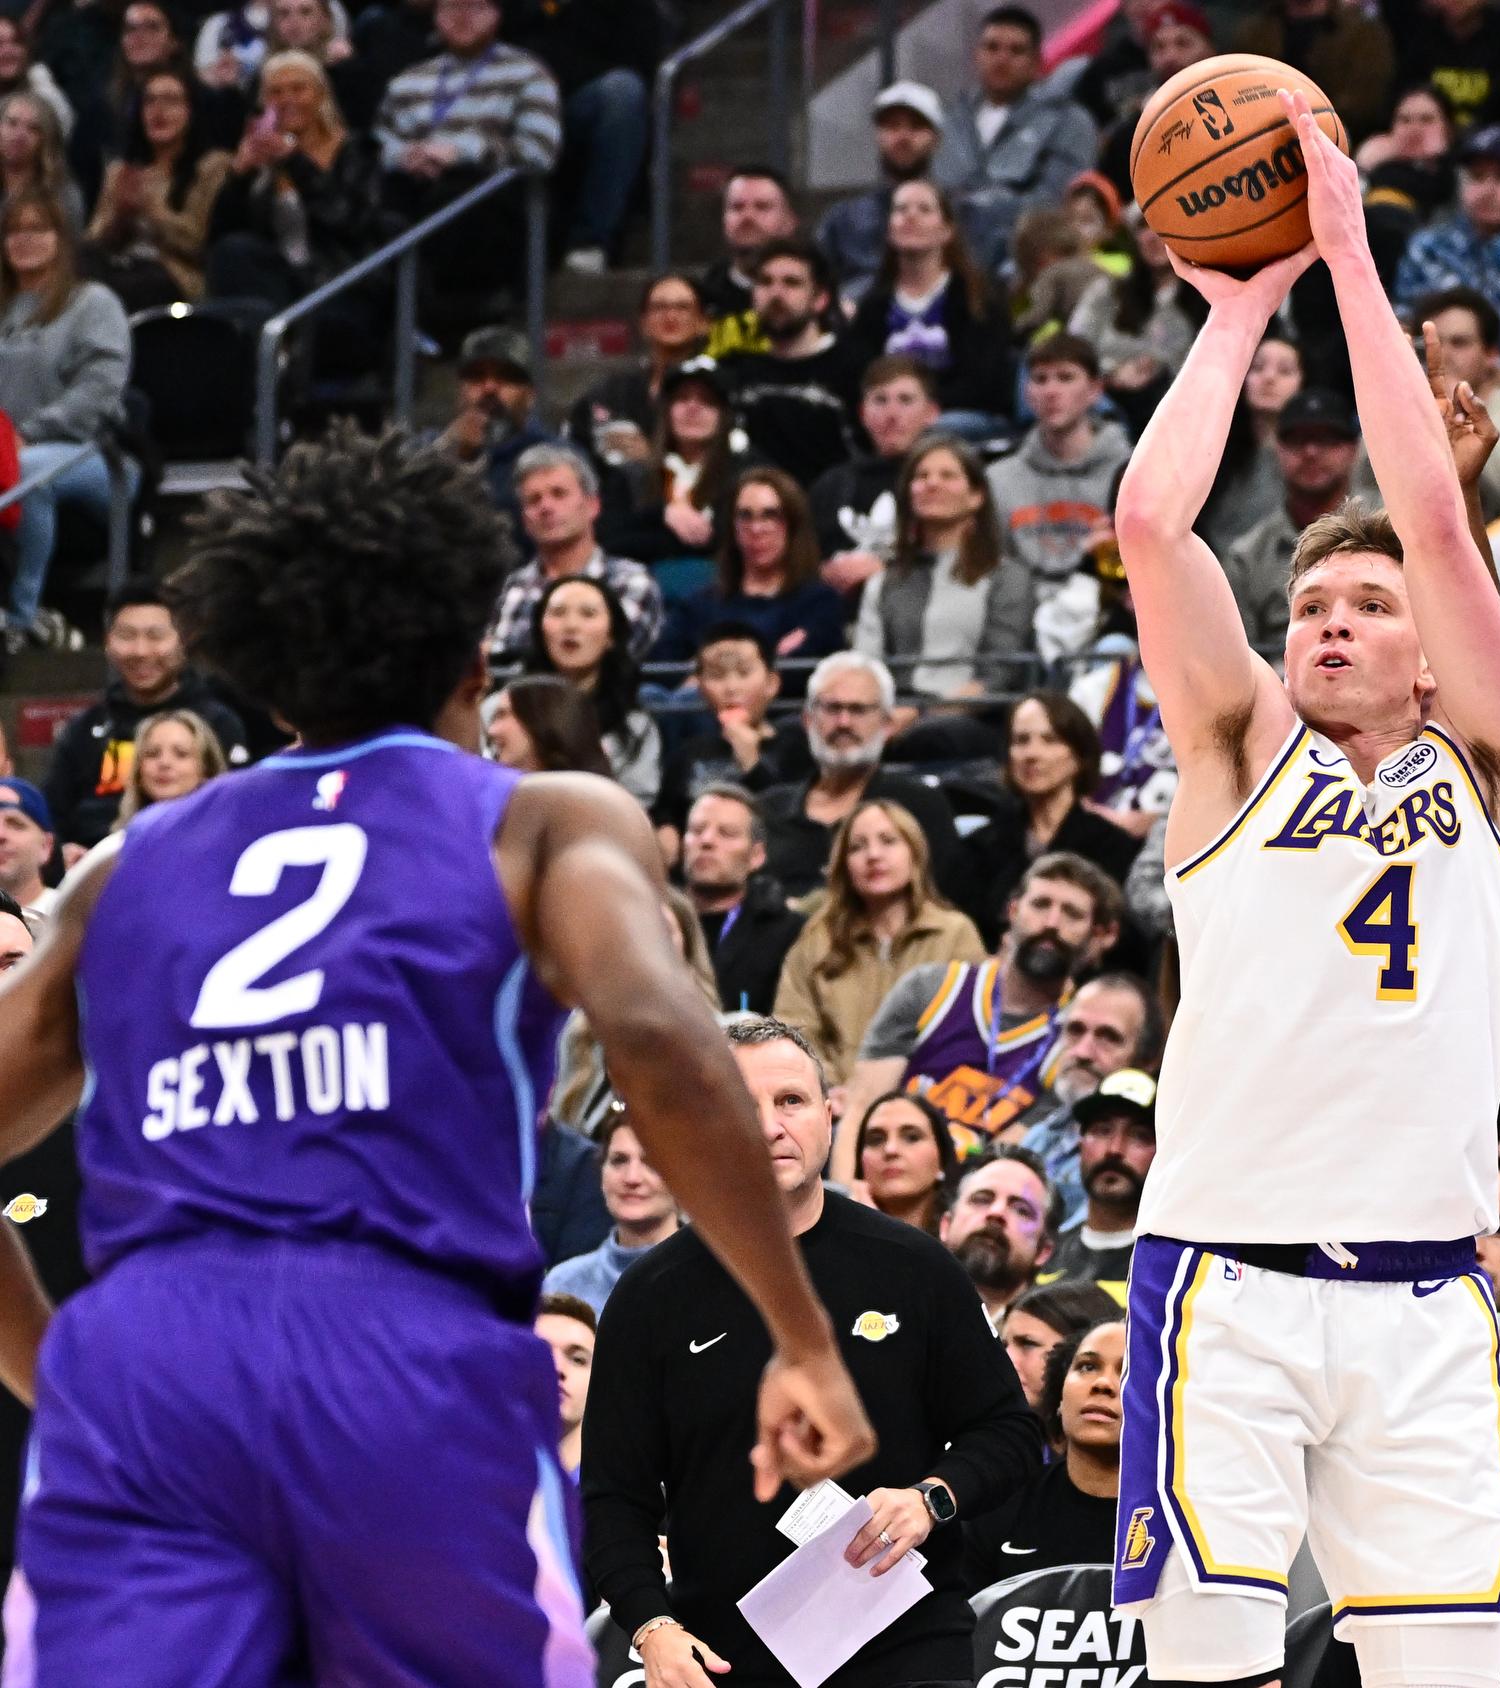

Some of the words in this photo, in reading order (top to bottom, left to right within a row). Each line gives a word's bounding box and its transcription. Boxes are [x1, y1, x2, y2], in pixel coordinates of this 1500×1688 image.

[1383, 748, 1431, 783] bibigo
[189, 822, 368, 1030] 2
[1334, 861, 1420, 1003] 4
[142, 1022, 390, 1142] SEXTON
[994, 1606, 1140, 1663] SEAT
